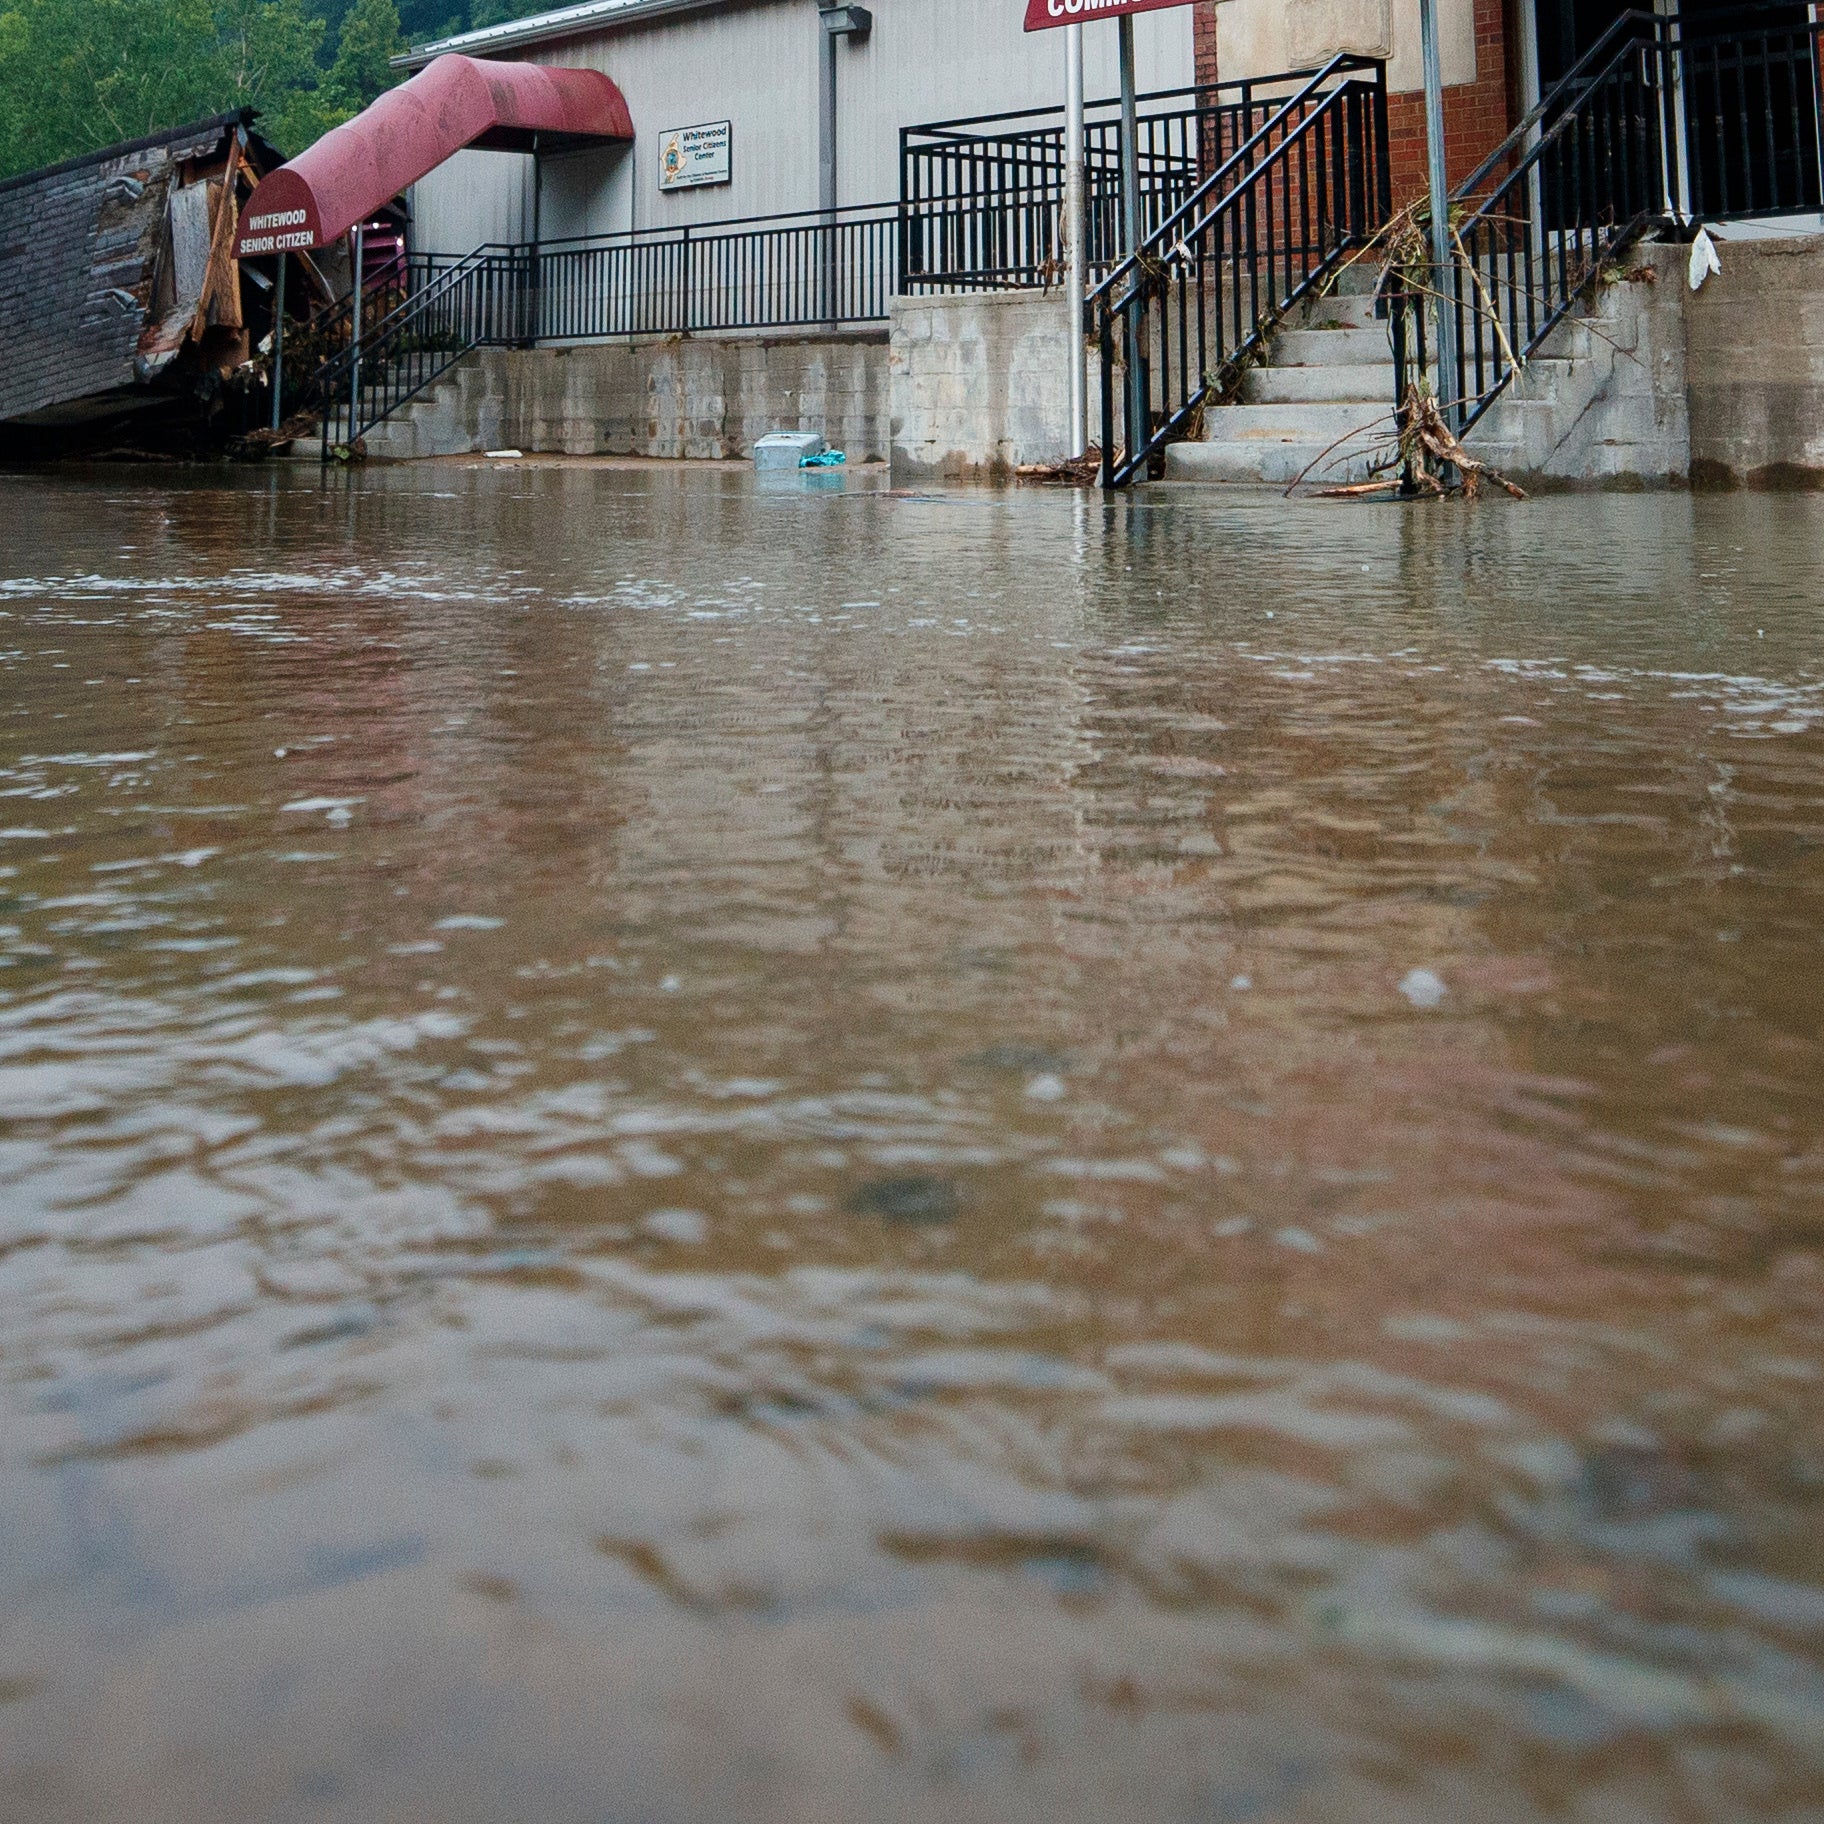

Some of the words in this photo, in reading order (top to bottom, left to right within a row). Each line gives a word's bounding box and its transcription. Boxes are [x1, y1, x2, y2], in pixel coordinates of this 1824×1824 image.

[683, 126, 726, 141] Whitewood
[683, 144, 702, 153] Senior
[694, 152, 715, 160] Center
[249, 209, 306, 230] WHITEWOOD
[240, 236, 274, 253] SENIOR
[276, 231, 314, 249] CITIZEN
